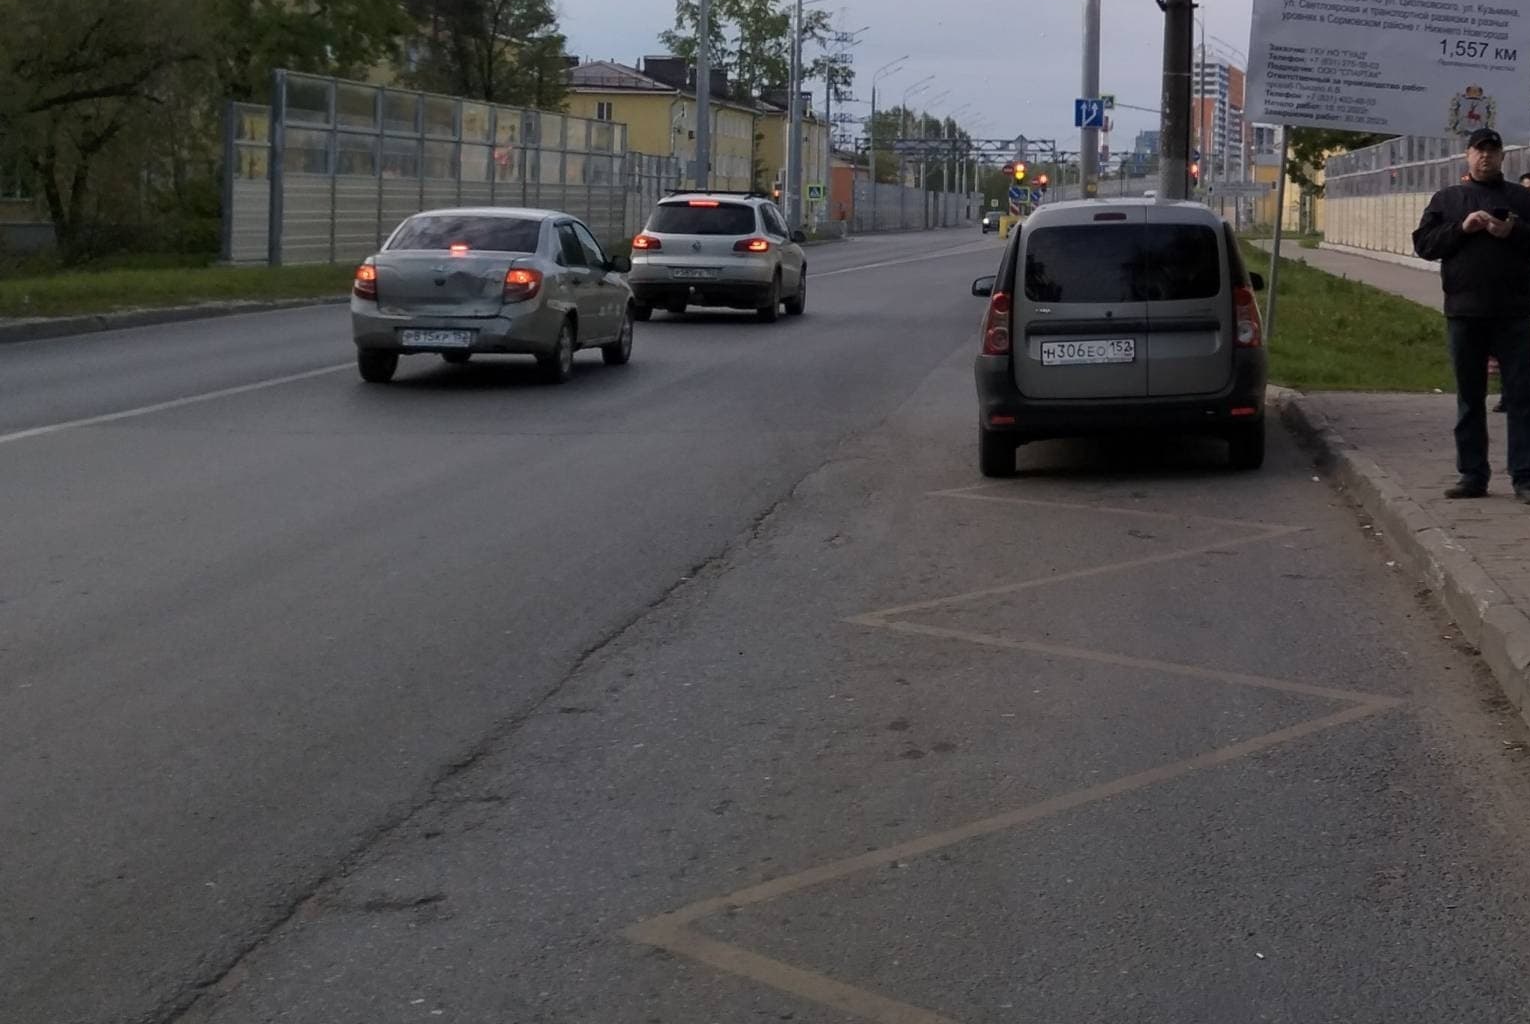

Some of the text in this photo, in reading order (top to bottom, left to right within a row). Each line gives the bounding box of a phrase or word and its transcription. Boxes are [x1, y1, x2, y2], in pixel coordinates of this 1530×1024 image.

[1440, 39, 1517, 61] 1,557 км
[1047, 340, 1133, 360] Н306ЕО 152
